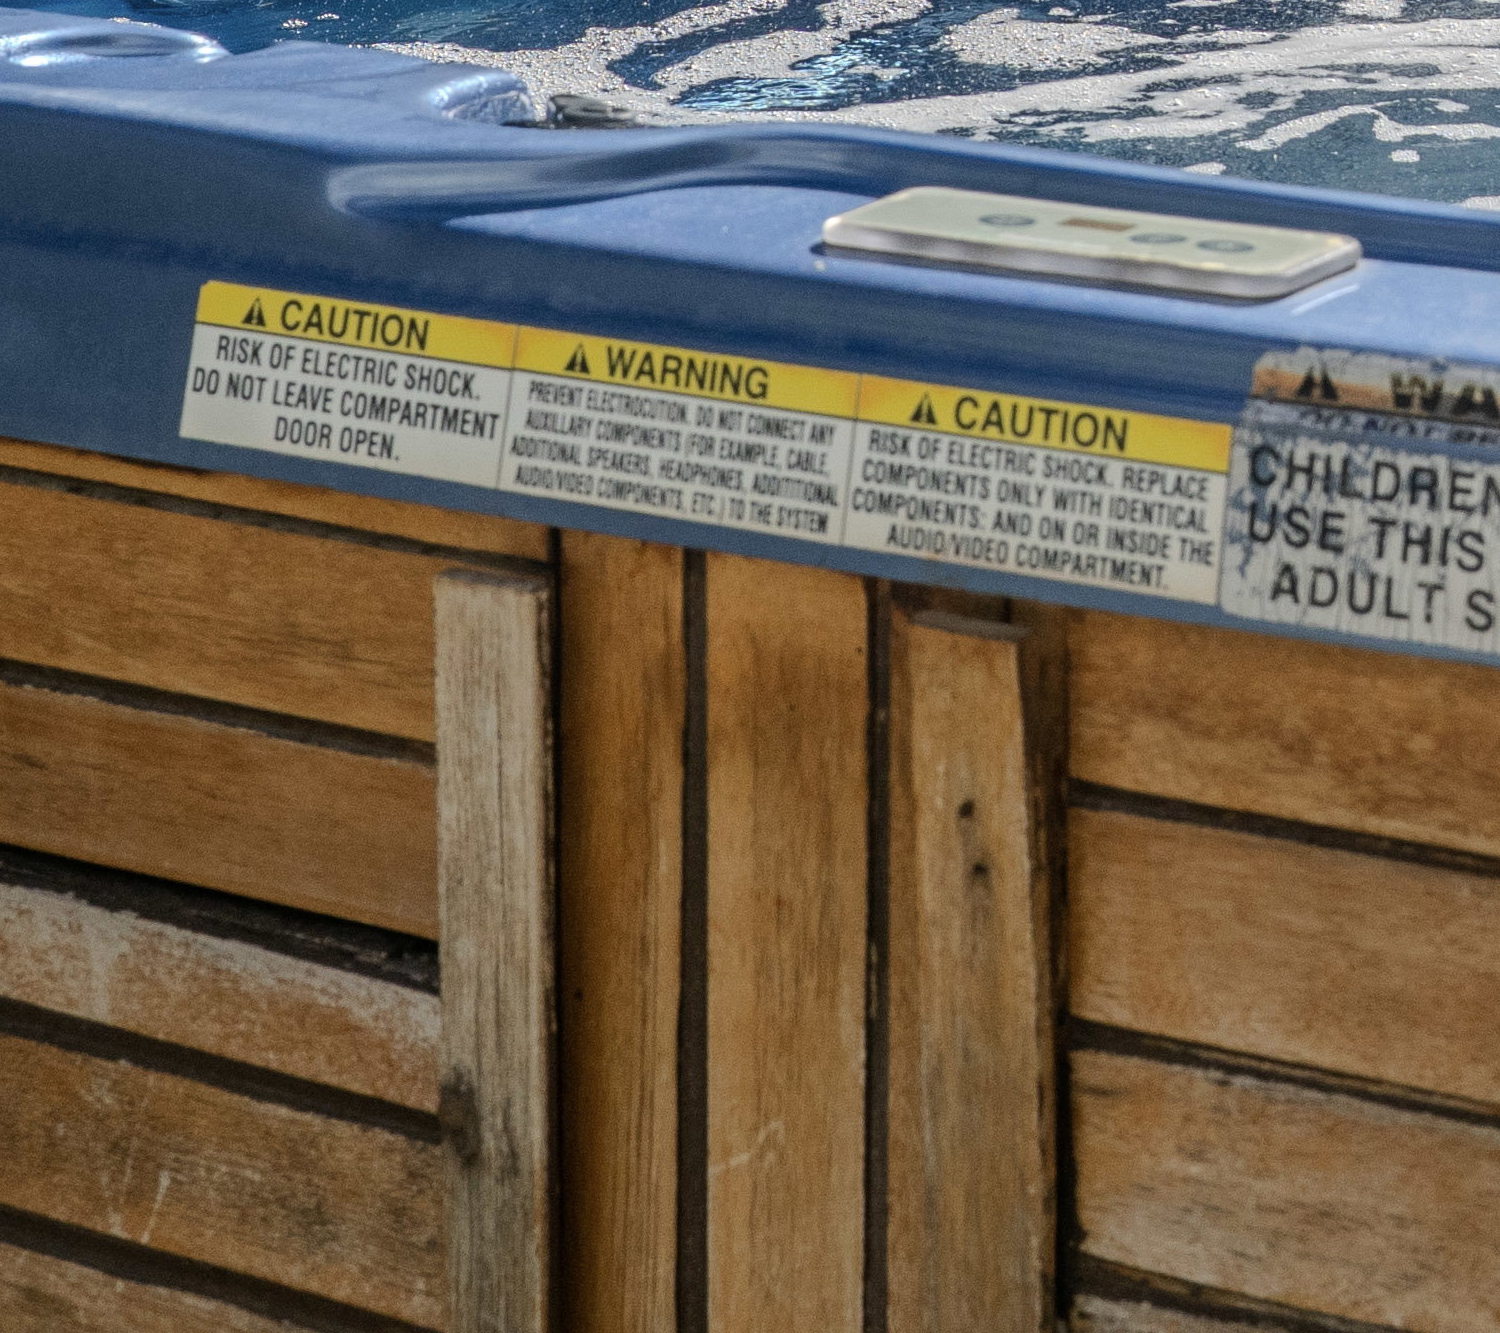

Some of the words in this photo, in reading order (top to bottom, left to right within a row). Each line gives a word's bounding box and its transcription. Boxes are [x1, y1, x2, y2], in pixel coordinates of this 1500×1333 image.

[280, 299, 430, 351] CAUTION
[216, 334, 262, 366] RISK
[269, 343, 292, 370] OF
[301, 347, 398, 386] ELECTRIC
[404, 363, 480, 400] SHOCK.
[606, 345, 770, 400] WARNING
[192, 367, 219, 395] DO
[225, 372, 267, 403] NOT
[272, 379, 332, 414] LEAVE
[340, 389, 500, 440] COMPARTMENT
[528, 380, 584, 407] PREVENT
[696, 404, 713, 428] DO
[718, 408, 744, 432] NOT
[747, 412, 807, 442] CONNECT
[810, 422, 836, 446] ANY
[953, 395, 1129, 453] CAUTION
[274, 416, 332, 449] DOOR
[339, 427, 400, 461] OPEN.
[509, 434, 581, 467] ADDITIONAL
[596, 418, 682, 453] COMPONENTS
[867, 428, 911, 457] RISK
[918, 436, 943, 461] OF
[947, 439, 1036, 477] ELECTRIC
[1042, 453, 1114, 488] SHOCK.
[1122, 465, 1211, 502] REPLACE
[729, 496, 746, 521] TO
[749, 500, 775, 525] THE
[862, 459, 990, 500] COMPONENTS
[999, 478, 1045, 510] ONLY
[1052, 484, 1102, 516] WITH
[1108, 493, 1207, 534] IDENTICAL
[886, 524, 1010, 565] AUDIO/VIDEO
[1014, 542, 1169, 591] COMPARTMENT.
[992, 509, 1032, 539] AND
[1039, 515, 1066, 543] ON
[1073, 520, 1099, 547] OR
[1105, 523, 1171, 559] INSIDE
[1178, 535, 1214, 567] THE
[1248, 501, 1346, 555] USE
[1368, 515, 1486, 573] THIS
[1269, 562, 1444, 624] ADULT
